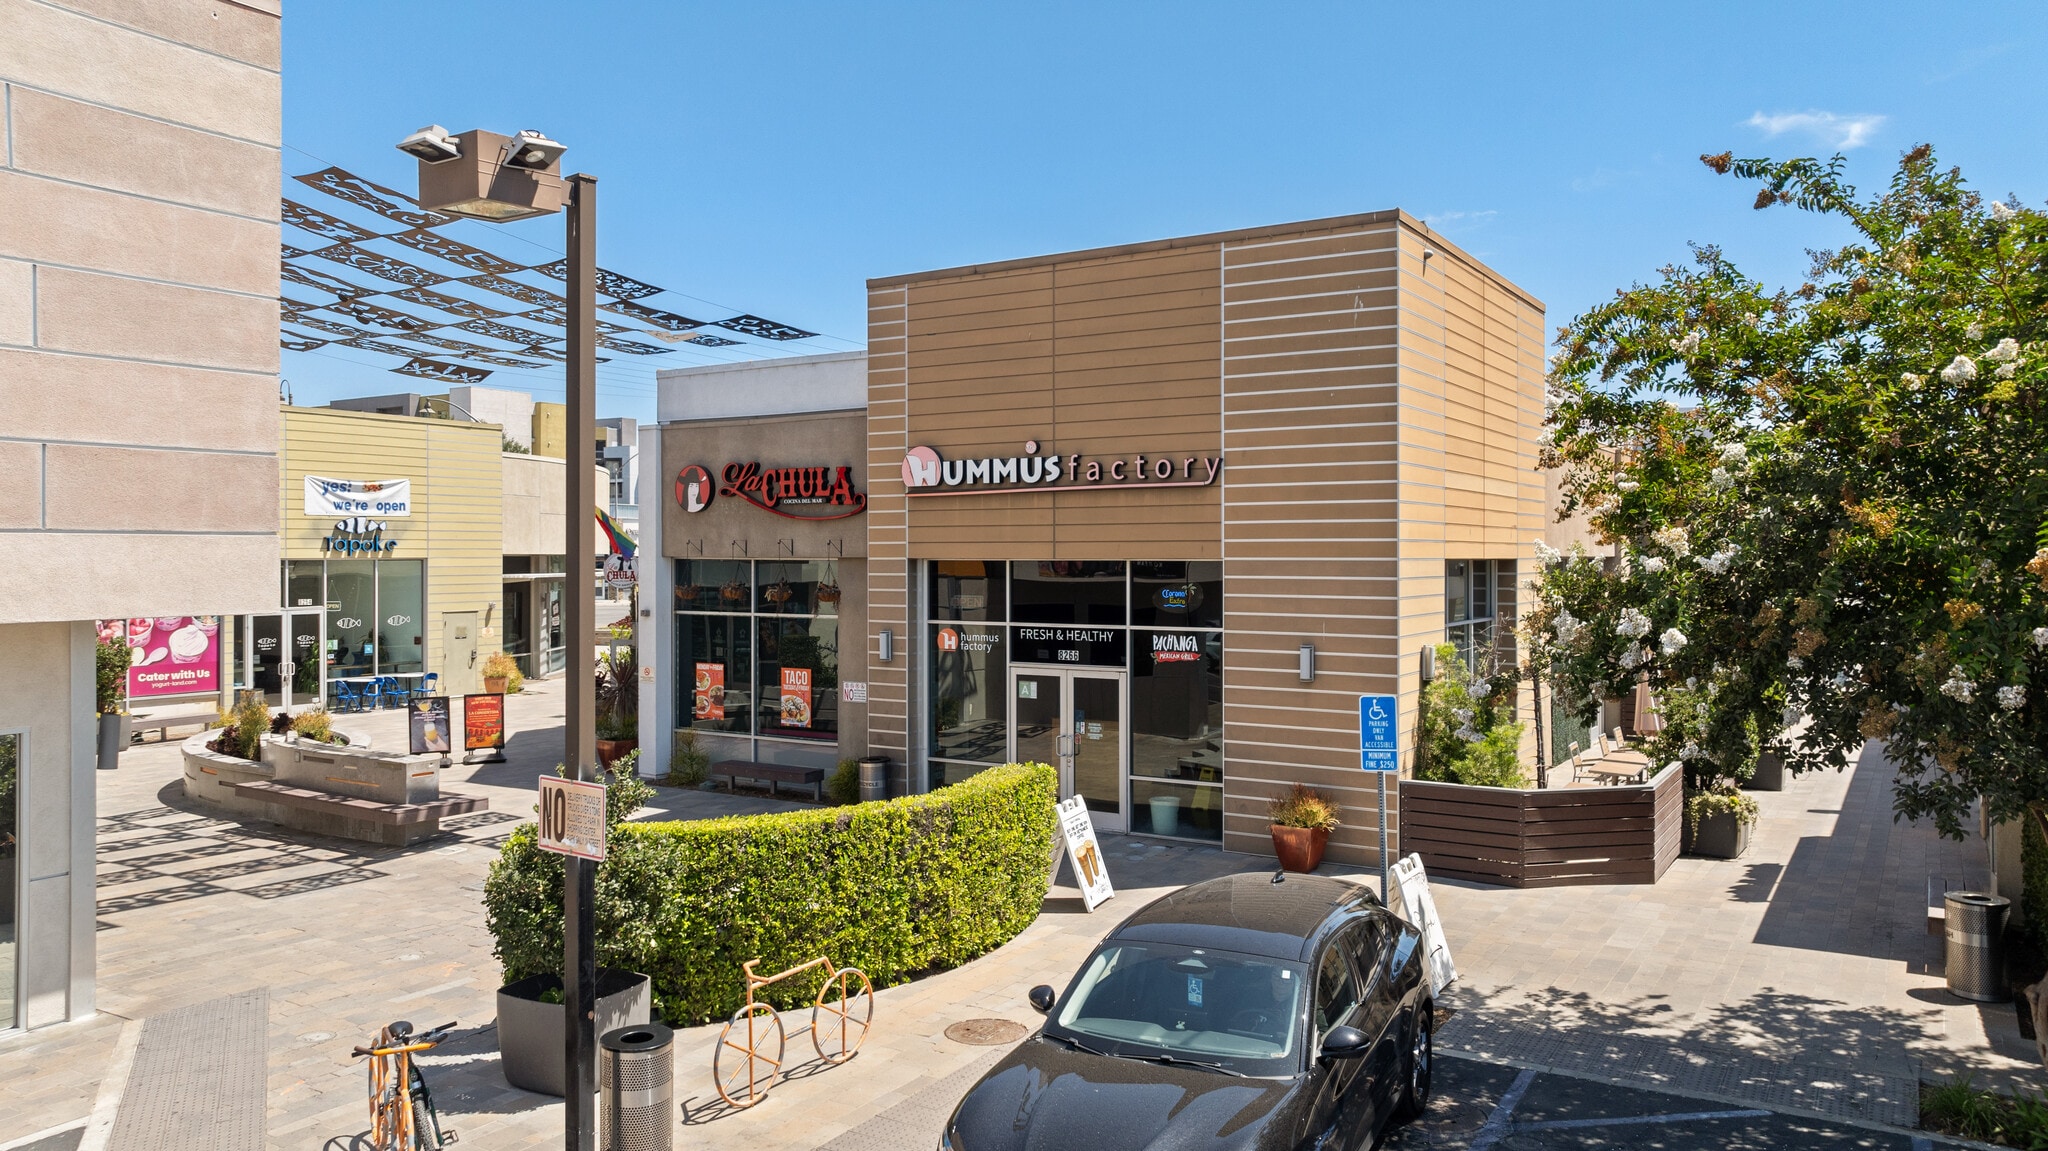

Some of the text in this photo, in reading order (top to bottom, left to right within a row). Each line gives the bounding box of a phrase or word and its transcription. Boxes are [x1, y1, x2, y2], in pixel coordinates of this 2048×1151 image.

[903, 447, 1222, 487] HUMMUS factory
[719, 461, 856, 507] La CHULA
[333, 499, 406, 514] we're open
[607, 570, 636, 582] CHULA
[960, 632, 999, 642] hummus
[1020, 628, 1114, 642] FRESH & HEALTHY
[960, 641, 992, 653] factory
[1152, 634, 1198, 652] PACHANGA
[1058, 650, 1080, 661] 8266
[138, 669, 210, 682] Cater with Us
[784, 670, 808, 685] TACO
[152, 680, 197, 688] yogurt-land.com
[1021, 685, 1029, 695] A
[844, 689, 854, 700] NO
[542, 786, 566, 842] NO
